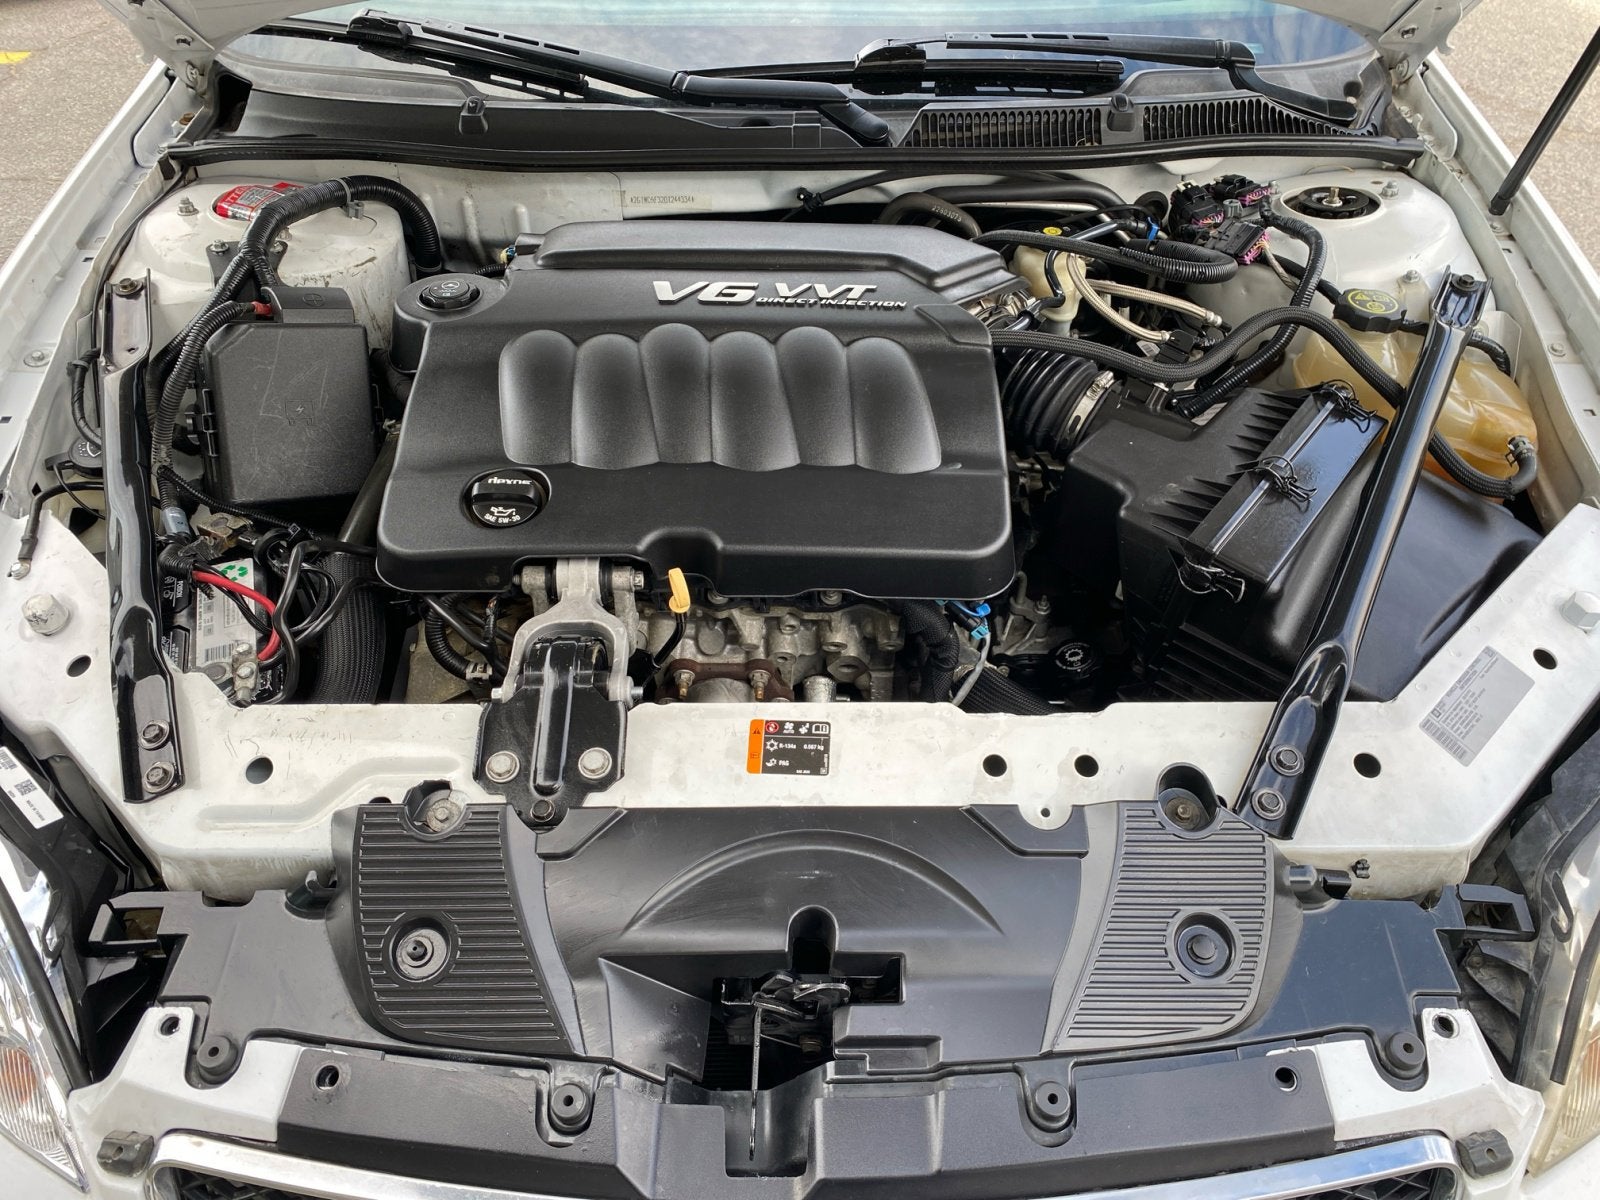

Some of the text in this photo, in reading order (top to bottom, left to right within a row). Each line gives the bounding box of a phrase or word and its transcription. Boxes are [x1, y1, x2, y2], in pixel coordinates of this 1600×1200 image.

[653, 281, 878, 305] V6 VVT
[756, 297, 907, 308] DIRECT INJECTION
[483, 513, 521, 523] SAE 5W-30
[176, 580, 184, 599] POISON
